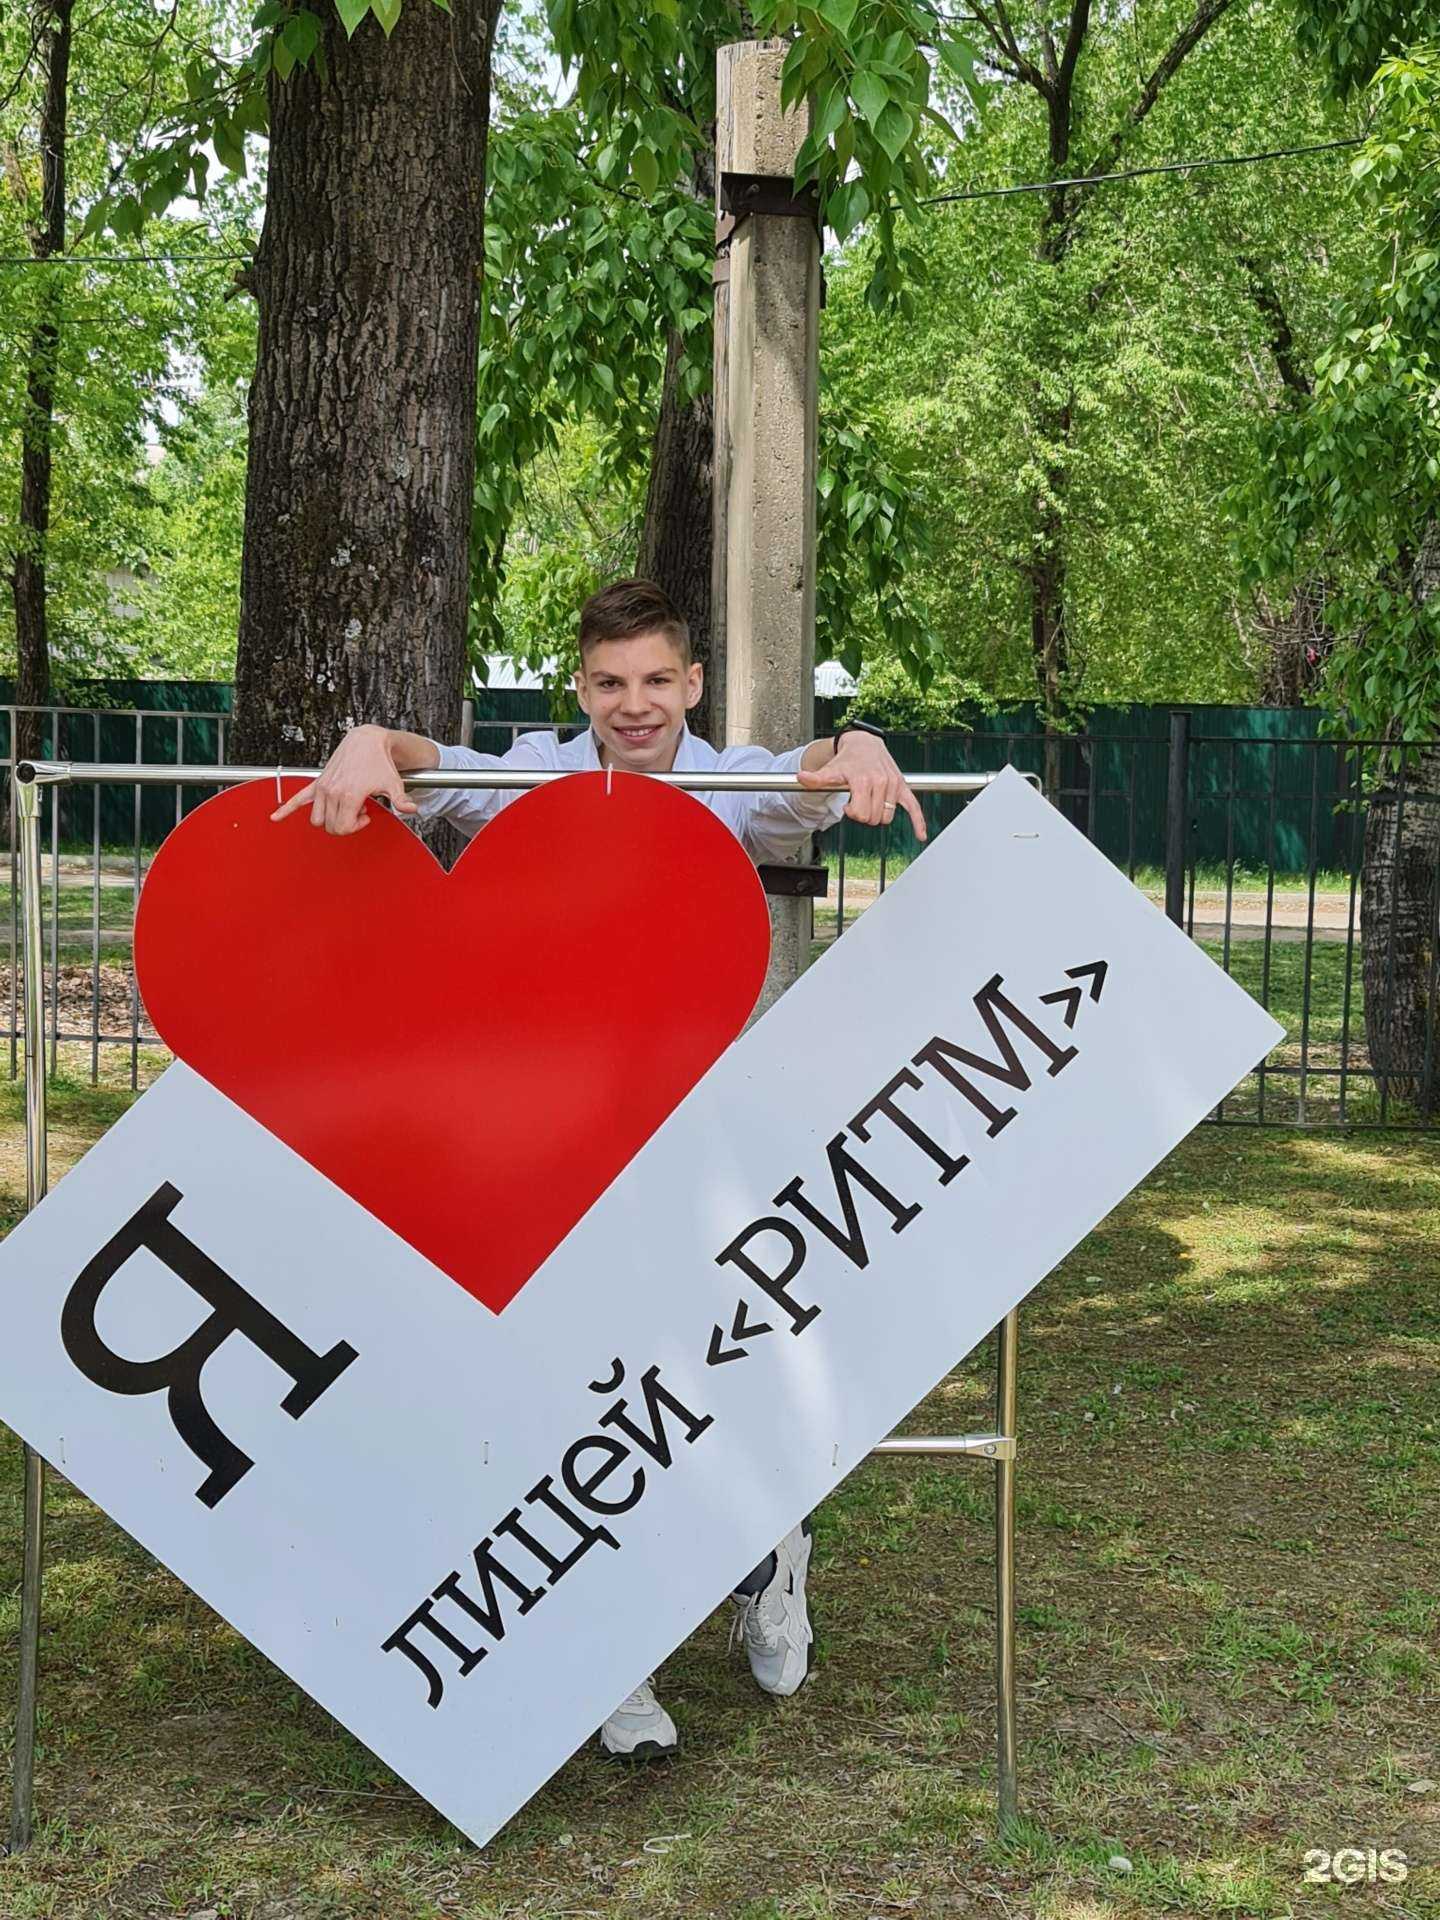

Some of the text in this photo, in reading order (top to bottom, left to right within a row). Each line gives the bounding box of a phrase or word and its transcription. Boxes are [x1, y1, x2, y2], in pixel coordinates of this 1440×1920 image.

[60, 1180, 359, 1510] Я
[380, 960, 1108, 1710] лицей «РИТМ»
